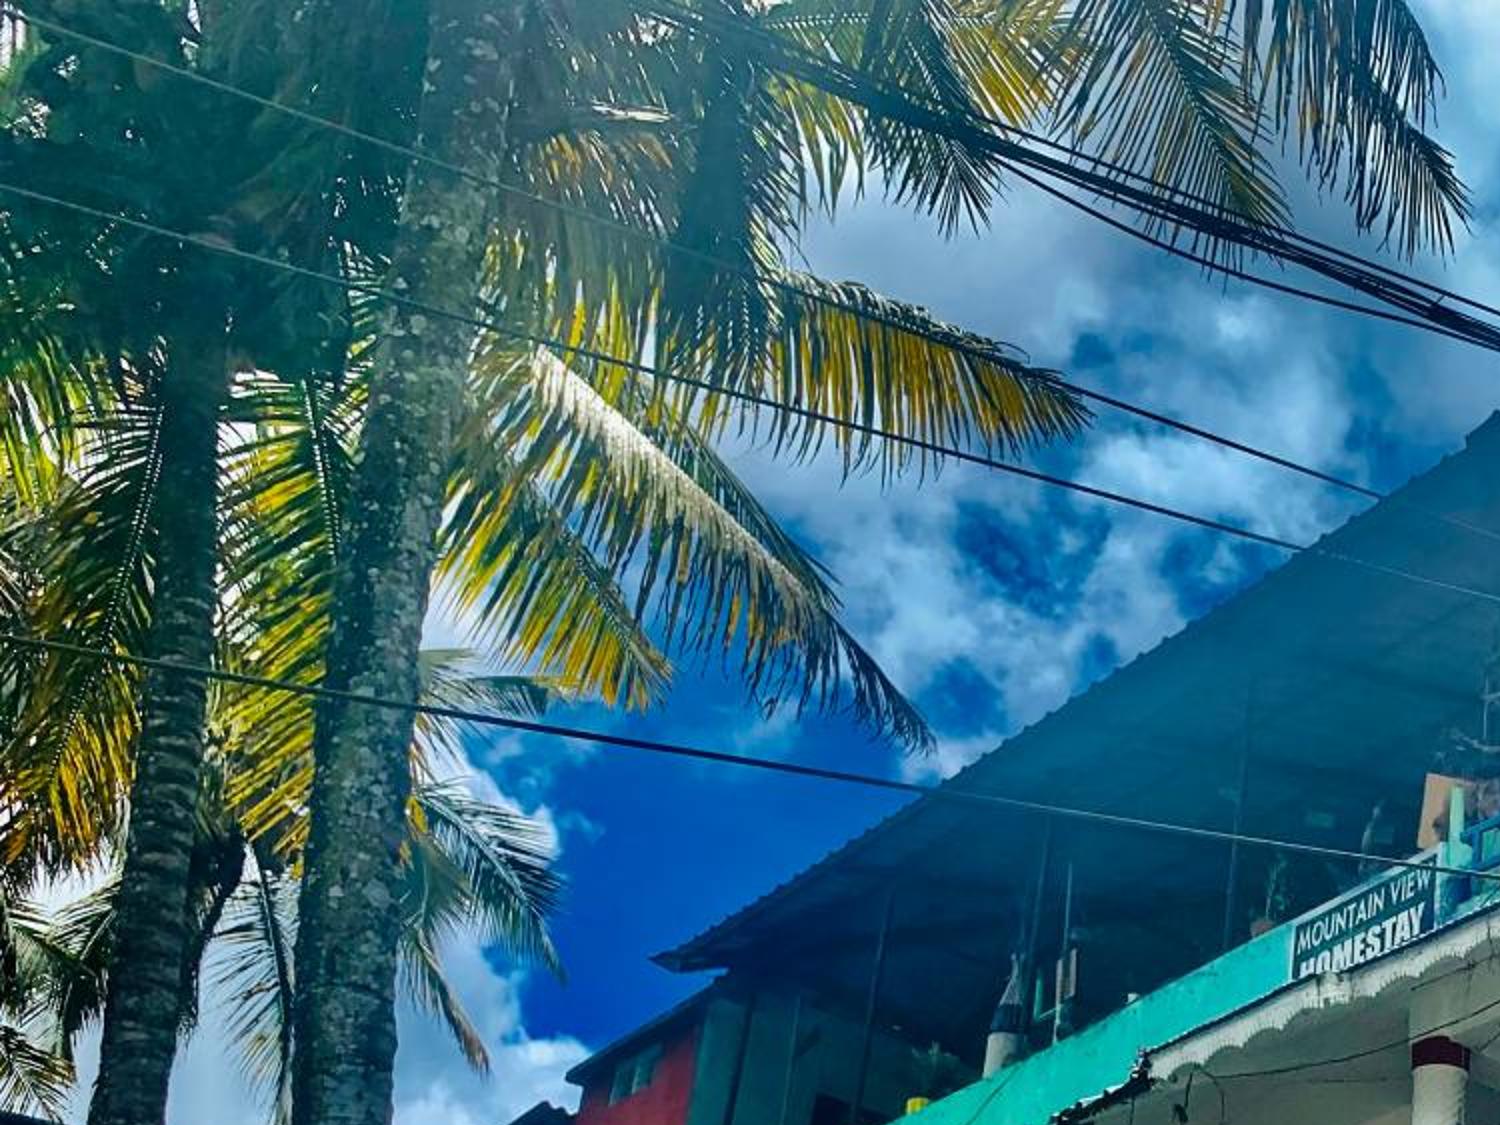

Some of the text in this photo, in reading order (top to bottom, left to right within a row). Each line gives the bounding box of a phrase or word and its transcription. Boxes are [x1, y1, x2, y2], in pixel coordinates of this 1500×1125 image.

[1298, 866, 1432, 951] MOUNTAIN VIEW
[1300, 904, 1425, 977] HOMESTAY
